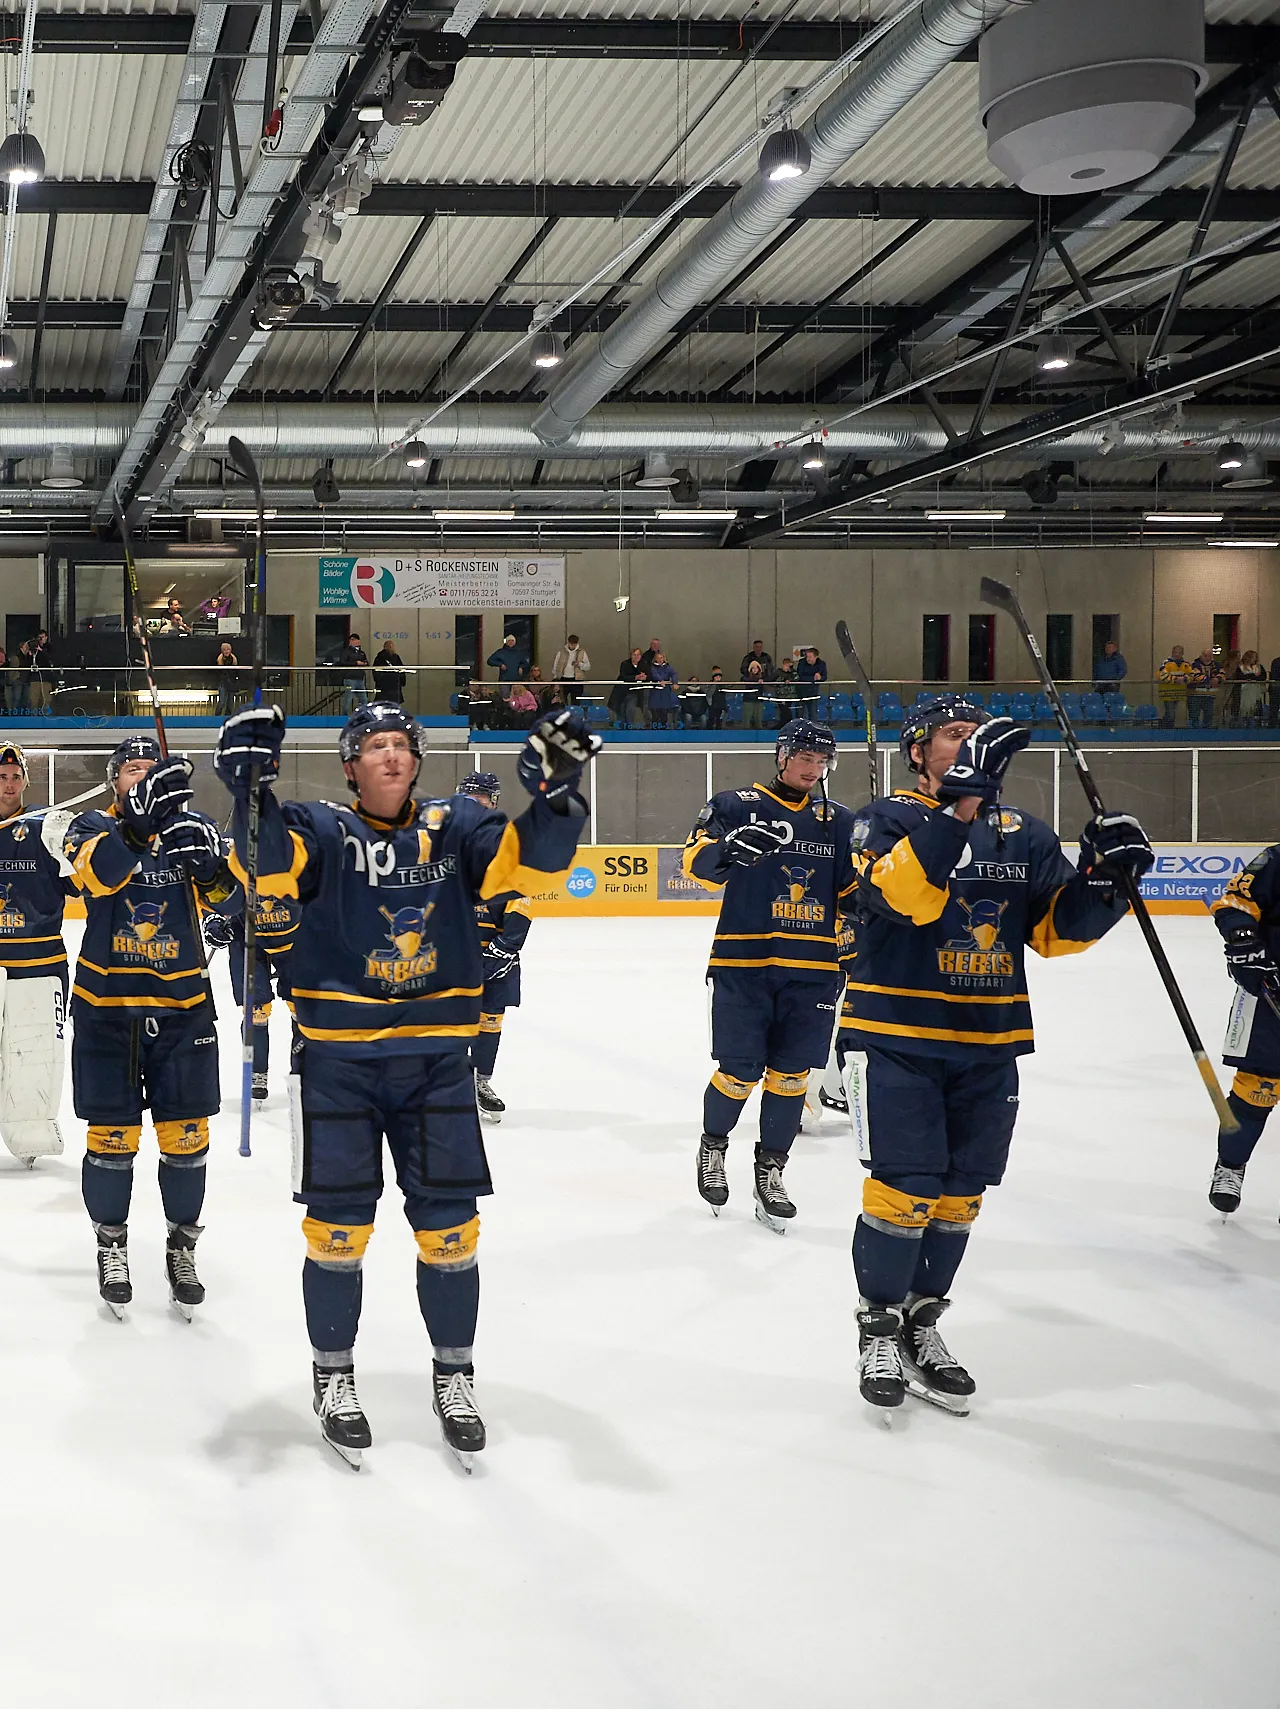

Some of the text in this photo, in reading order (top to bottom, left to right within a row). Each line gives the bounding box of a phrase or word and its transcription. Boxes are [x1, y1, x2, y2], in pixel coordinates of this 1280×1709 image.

[323, 561, 349, 569] Schöne
[395, 560, 499, 572] D + S ROCKENSTEIN
[323, 569, 344, 577] Bäder
[507, 580, 540, 589] Gomaringer
[323, 587, 349, 596] Wohlige
[449, 589, 498, 597] 0711/765 32 24
[531, 589, 557, 597] Stuttgart
[323, 596, 348, 604] Wärme
[439, 598, 562, 607] www.rockenstein-sanitaer.de
[604, 855, 648, 877] SSB
[568, 879, 594, 890] 49€
[605, 884, 648, 893] Für Dich!
[1138, 884, 1157, 896] die
[1164, 884, 1206, 896] Netze
[112, 937, 180, 960] REBELS
[938, 950, 1013, 976] REBELS
[53, 990, 64, 1040] CCM
[853, 1061, 864, 1151] WASCHWELT
